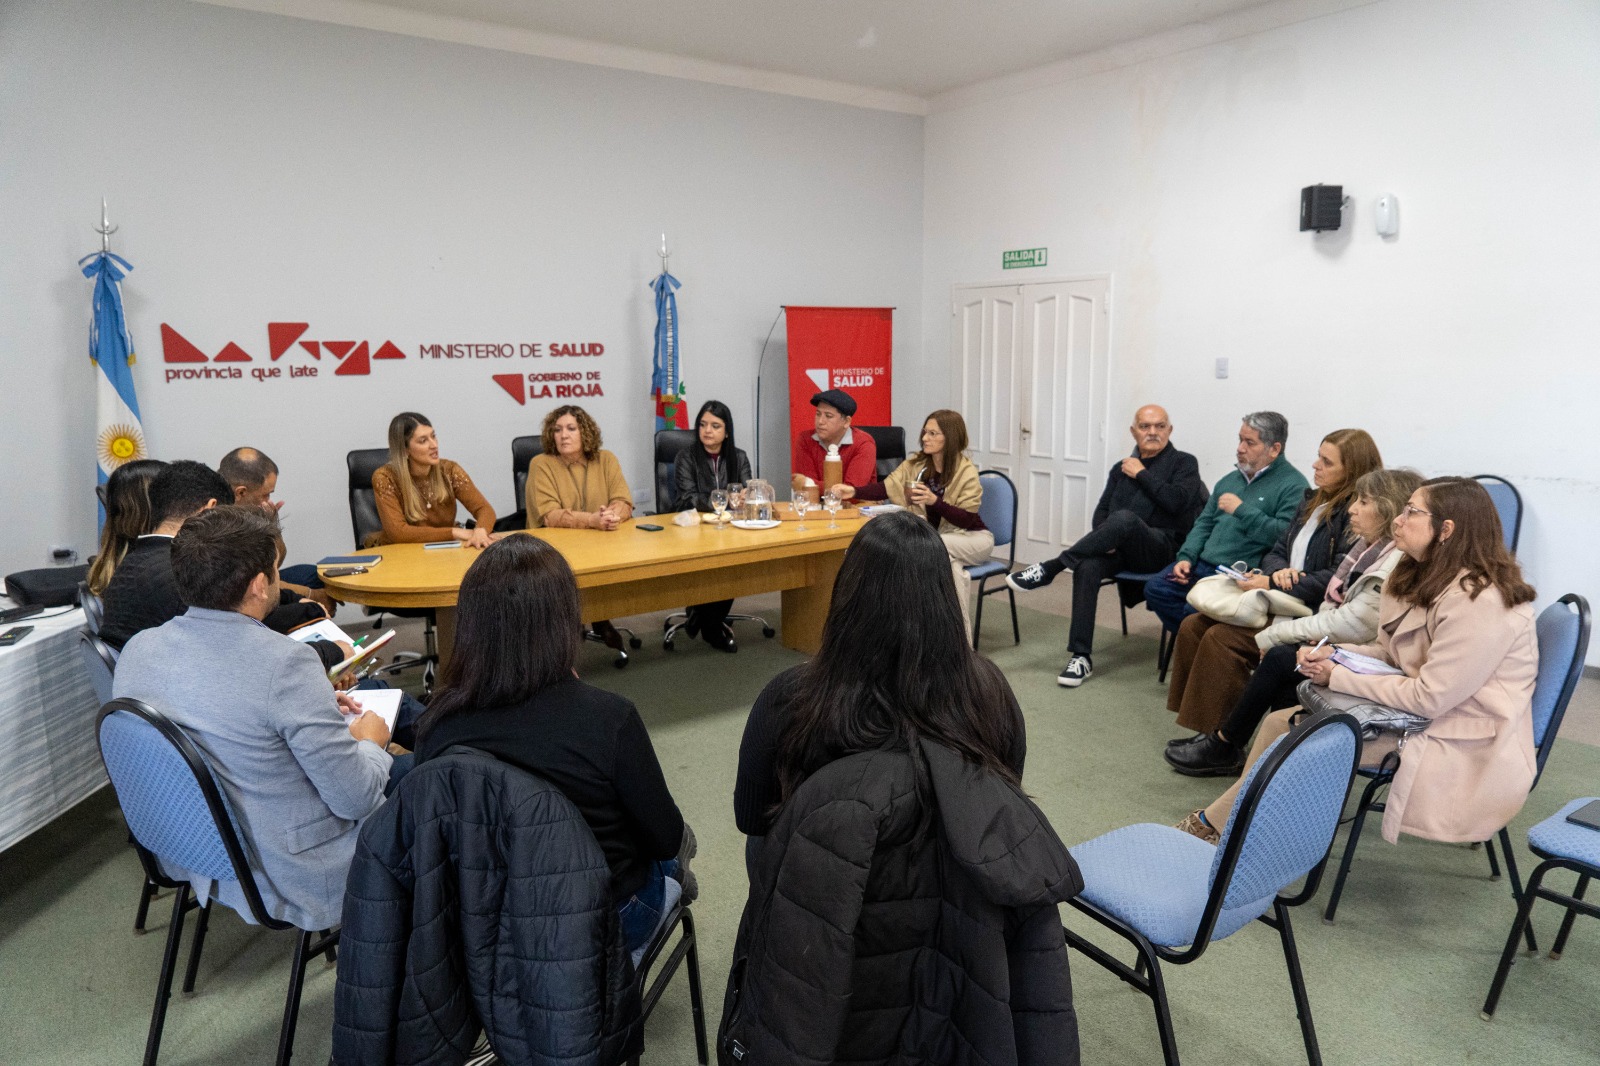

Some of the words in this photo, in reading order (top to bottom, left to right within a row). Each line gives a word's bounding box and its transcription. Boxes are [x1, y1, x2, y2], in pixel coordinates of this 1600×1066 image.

[1004, 251, 1034, 262] SALIDA
[420, 344, 514, 359] MINISTERIO
[520, 343, 542, 358] DE
[549, 342, 604, 357] SALUD
[165, 366, 243, 383] provincia
[251, 368, 281, 382] que
[290, 364, 318, 378] late
[528, 373, 582, 382] GOBIERNO
[586, 371, 601, 381] DE
[832, 367, 873, 376] MINISTERIO
[874, 367, 884, 375] DE
[833, 376, 873, 387] SALUD
[529, 385, 552, 399] LA
[556, 383, 604, 398] RIOJA
